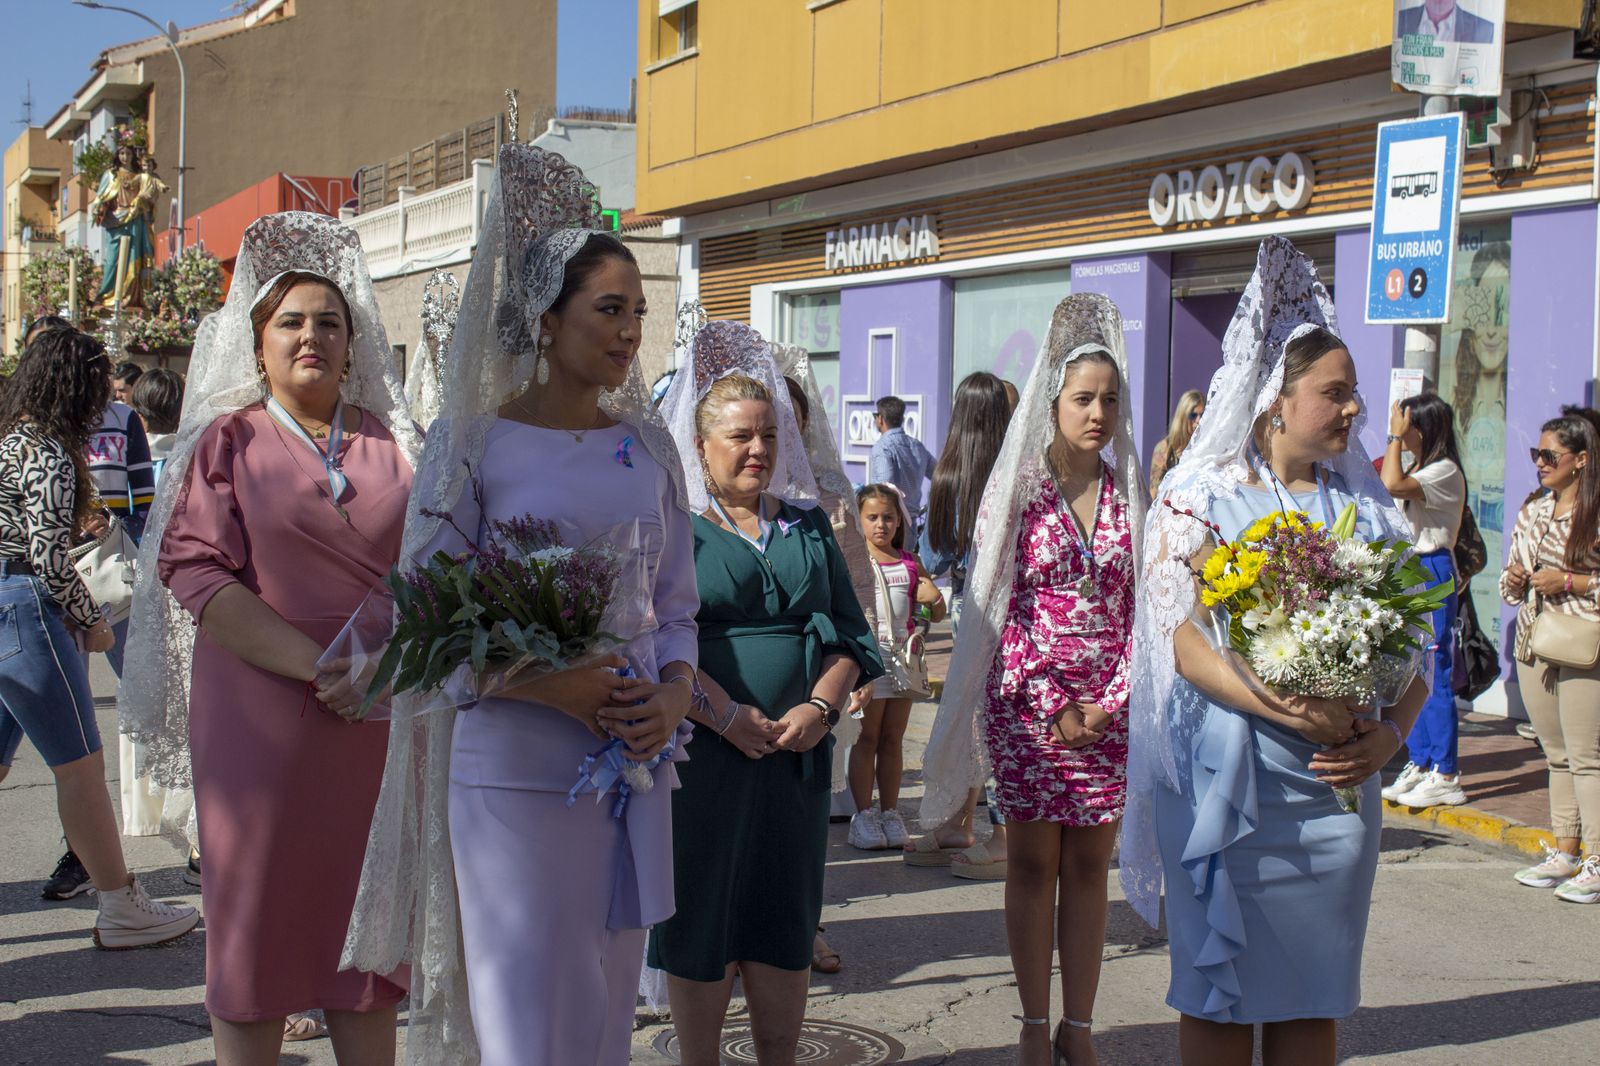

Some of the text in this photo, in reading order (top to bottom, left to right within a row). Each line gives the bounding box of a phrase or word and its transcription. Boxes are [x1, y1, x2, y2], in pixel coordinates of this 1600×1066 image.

[1402, 45, 1424, 56] VAMOS
[1401, 73, 1410, 84] LA
[1148, 152, 1311, 226] OROZCO
[825, 214, 936, 270] FARMACIA
[1377, 239, 1442, 260] BUS URBANO
[1104, 262, 1140, 275] MAGISTRALES
[1388, 274, 1422, 294] L1 2
